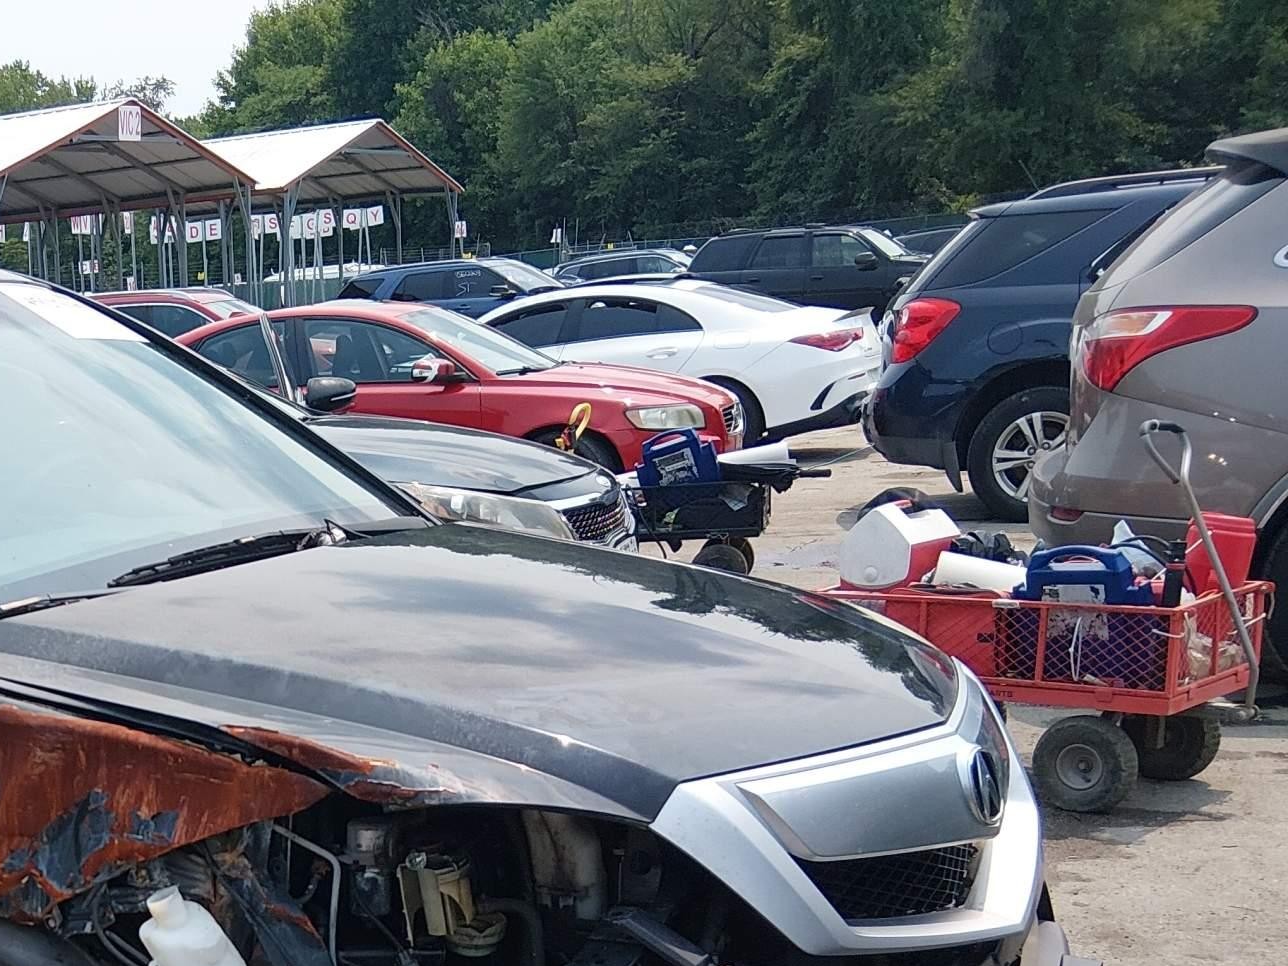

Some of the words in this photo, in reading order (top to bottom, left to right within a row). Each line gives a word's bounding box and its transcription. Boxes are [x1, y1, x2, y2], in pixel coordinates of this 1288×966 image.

[119, 110, 134, 135] VIC
[135, 111, 141, 136] 2
[323, 212, 332, 225] S
[346, 213, 357, 225] Q
[370, 209, 380, 222] Y
[209, 223, 218, 237] E
[268, 217, 278, 230] S
[189, 226, 199, 239] D
